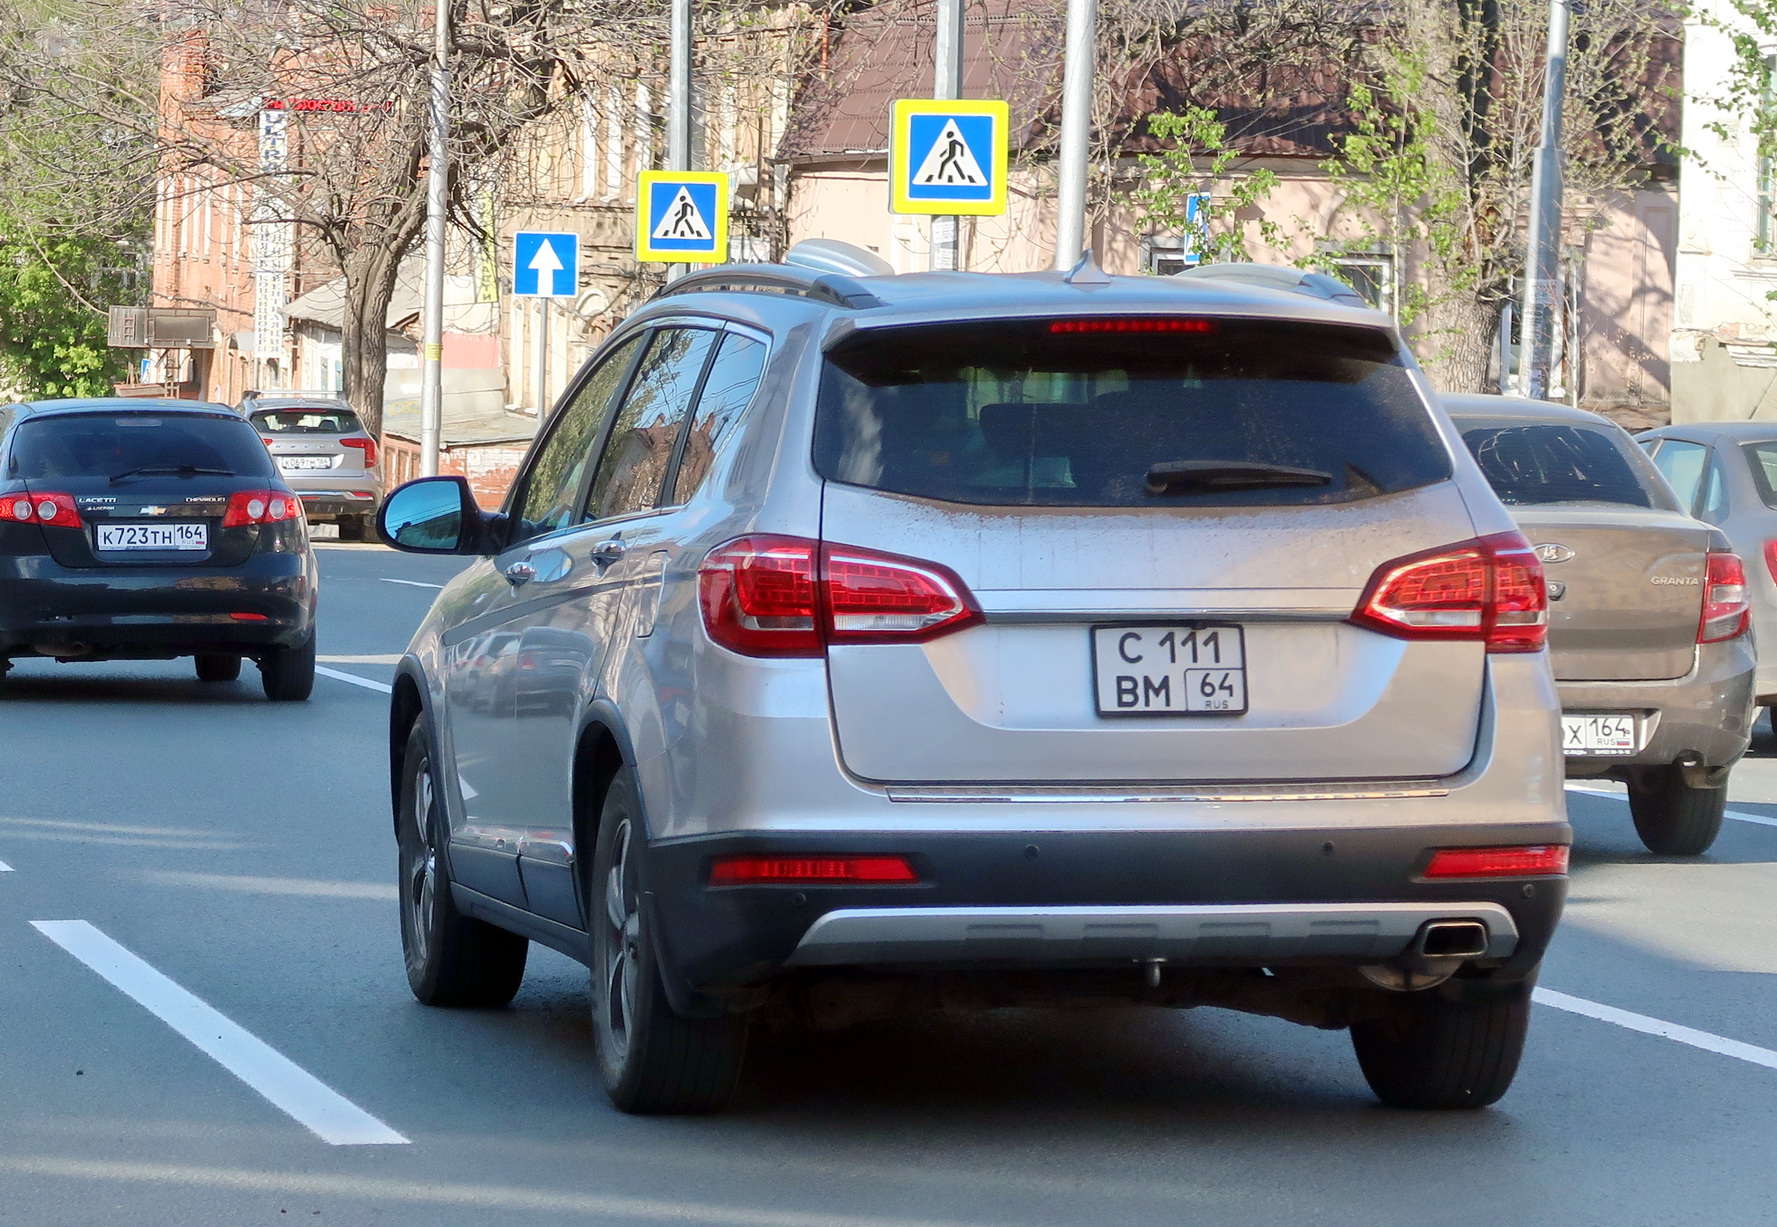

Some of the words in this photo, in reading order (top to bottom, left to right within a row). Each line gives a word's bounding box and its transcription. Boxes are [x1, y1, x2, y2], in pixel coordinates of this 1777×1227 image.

[258, 275, 268, 352] КОНДИЦИОНЕРЫ
[270, 275, 281, 352] ВЕНТИЛЯЦИЯ
[103, 527, 172, 545] К723ТН
[177, 525, 203, 540] 164
[1650, 575, 1699, 586] GRANTA
[1158, 631, 1220, 664] 111
[1116, 675, 1171, 708] ВМ
[1200, 672, 1234, 698] 64
[1204, 700, 1230, 709] RUS
[1588, 717, 1627, 738] 164
[1596, 738, 1617, 746] RUS
